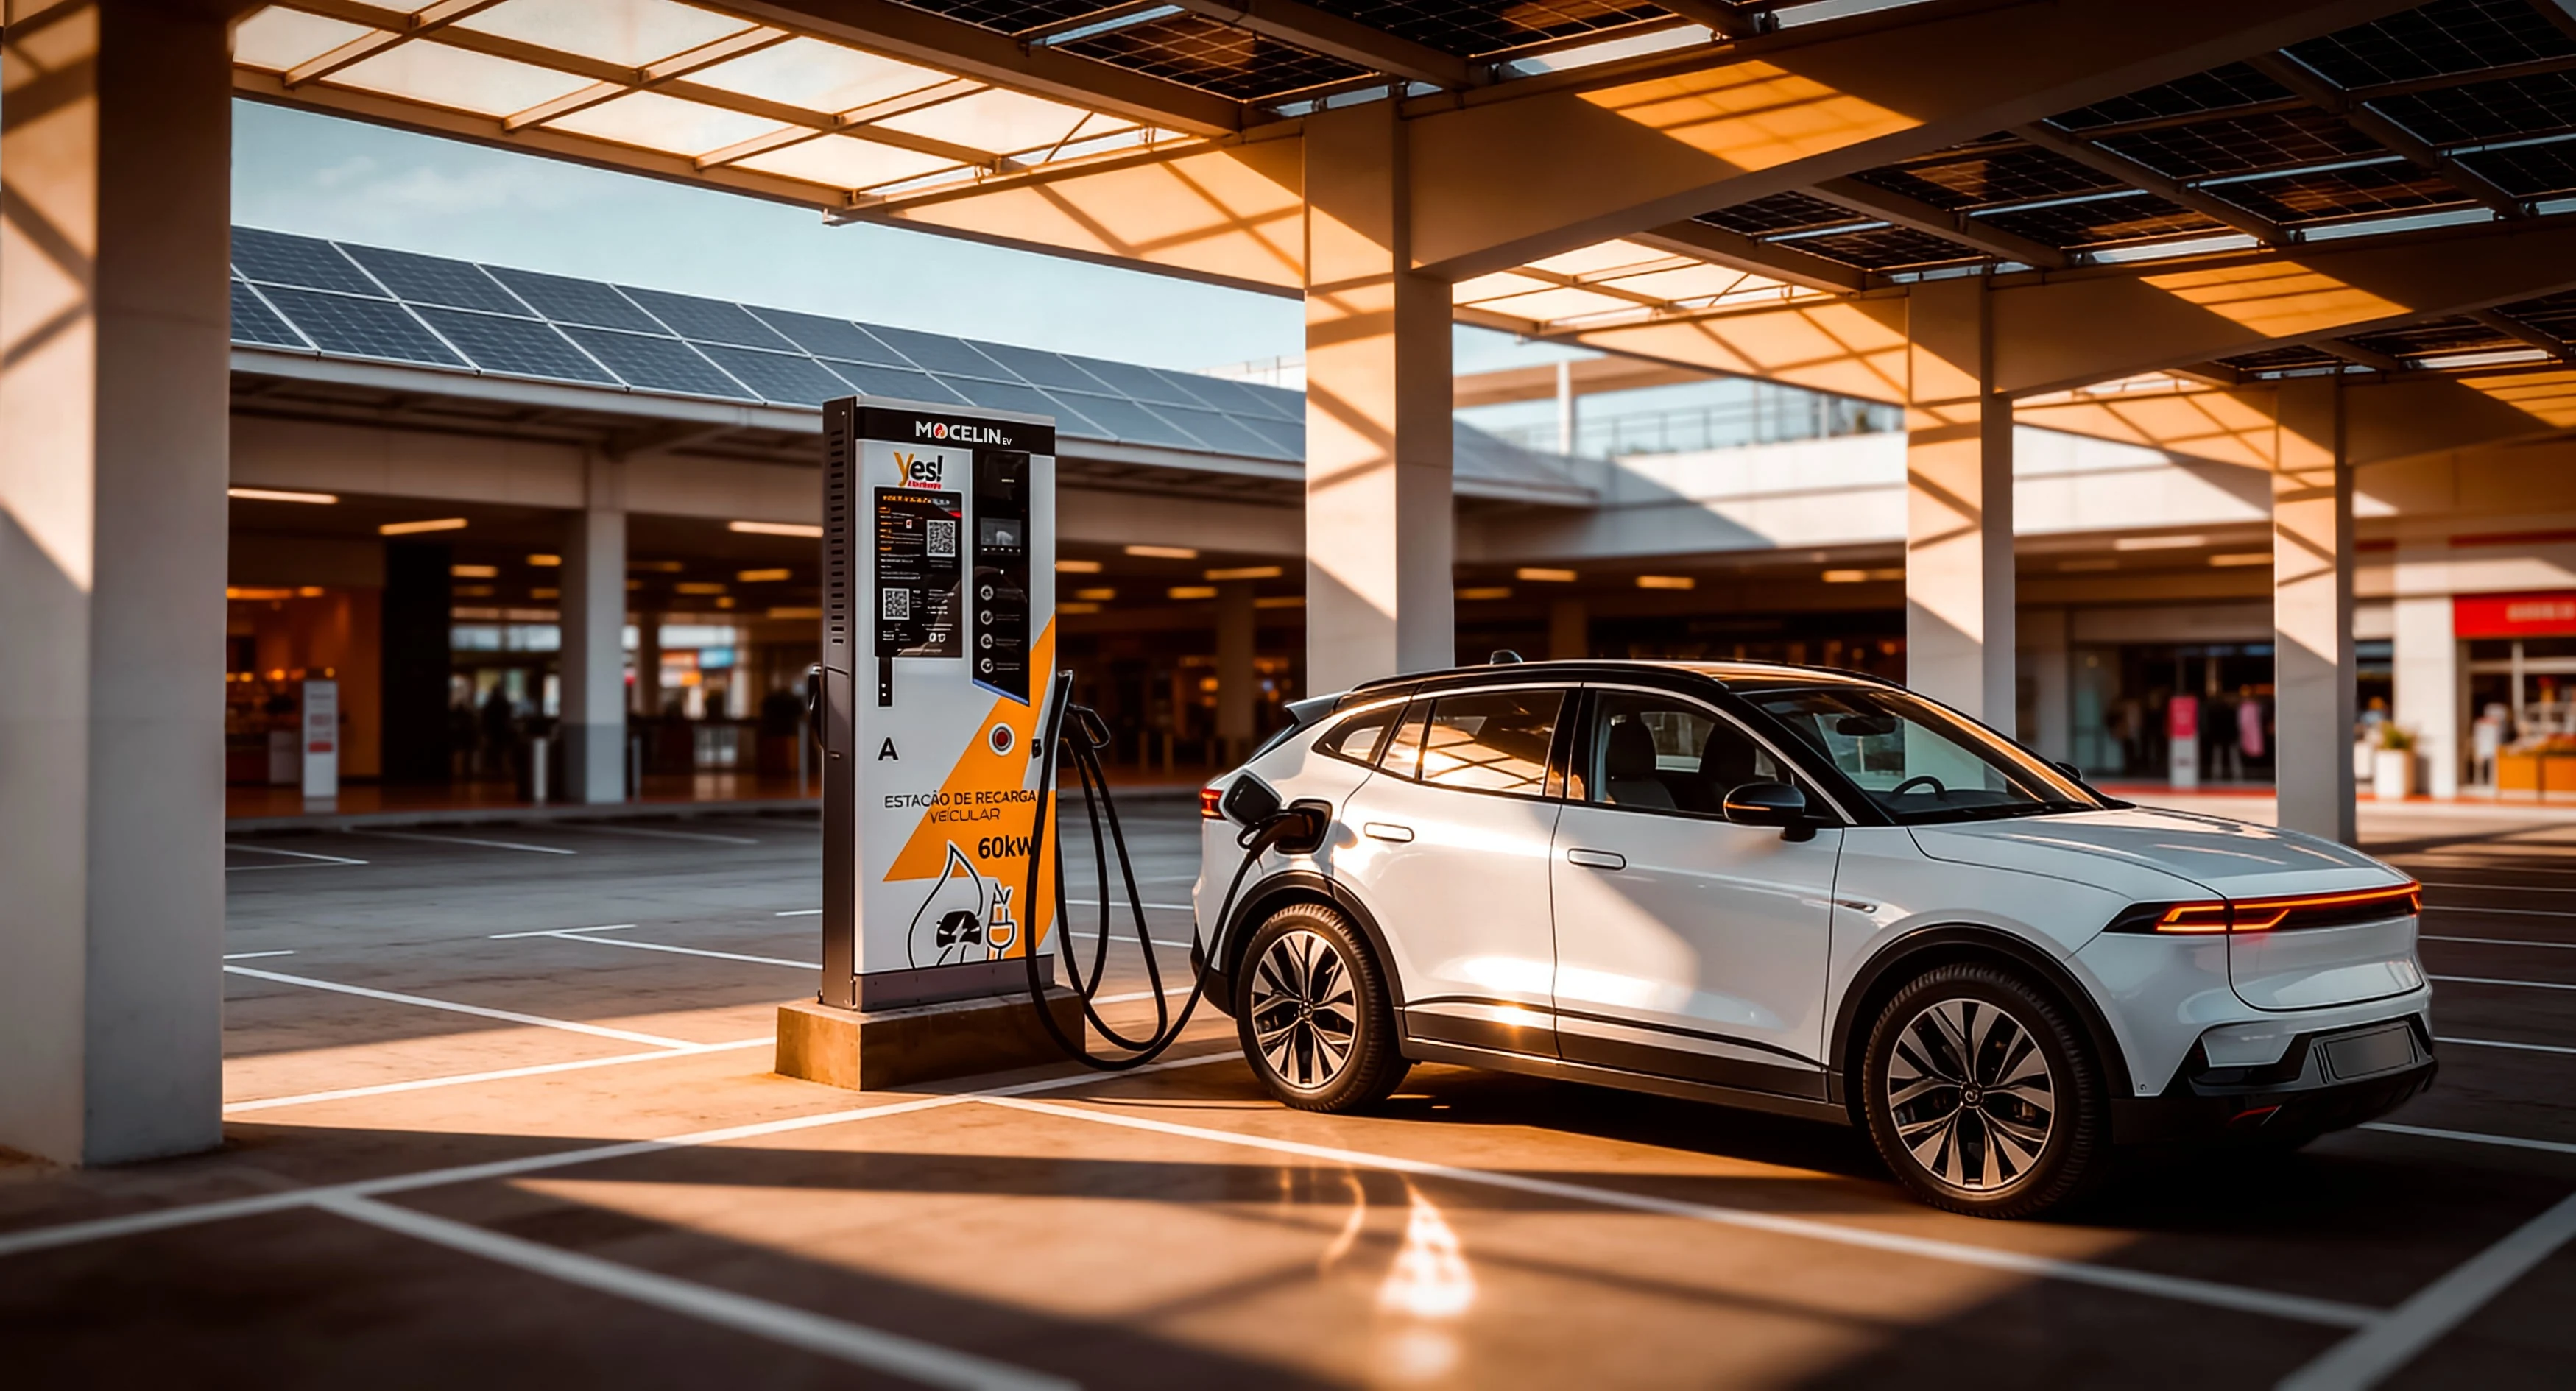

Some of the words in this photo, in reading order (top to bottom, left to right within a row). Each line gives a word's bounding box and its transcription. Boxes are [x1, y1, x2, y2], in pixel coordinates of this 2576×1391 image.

[915, 420, 1001, 445] MOCELIN
[1002, 437, 1012, 445] EV
[877, 737, 899, 761] A
[1031, 738, 1042, 759] B
[954, 792, 972, 805] DE
[975, 790, 1037, 804] RECARGA
[978, 835, 1031, 860] 60kW
